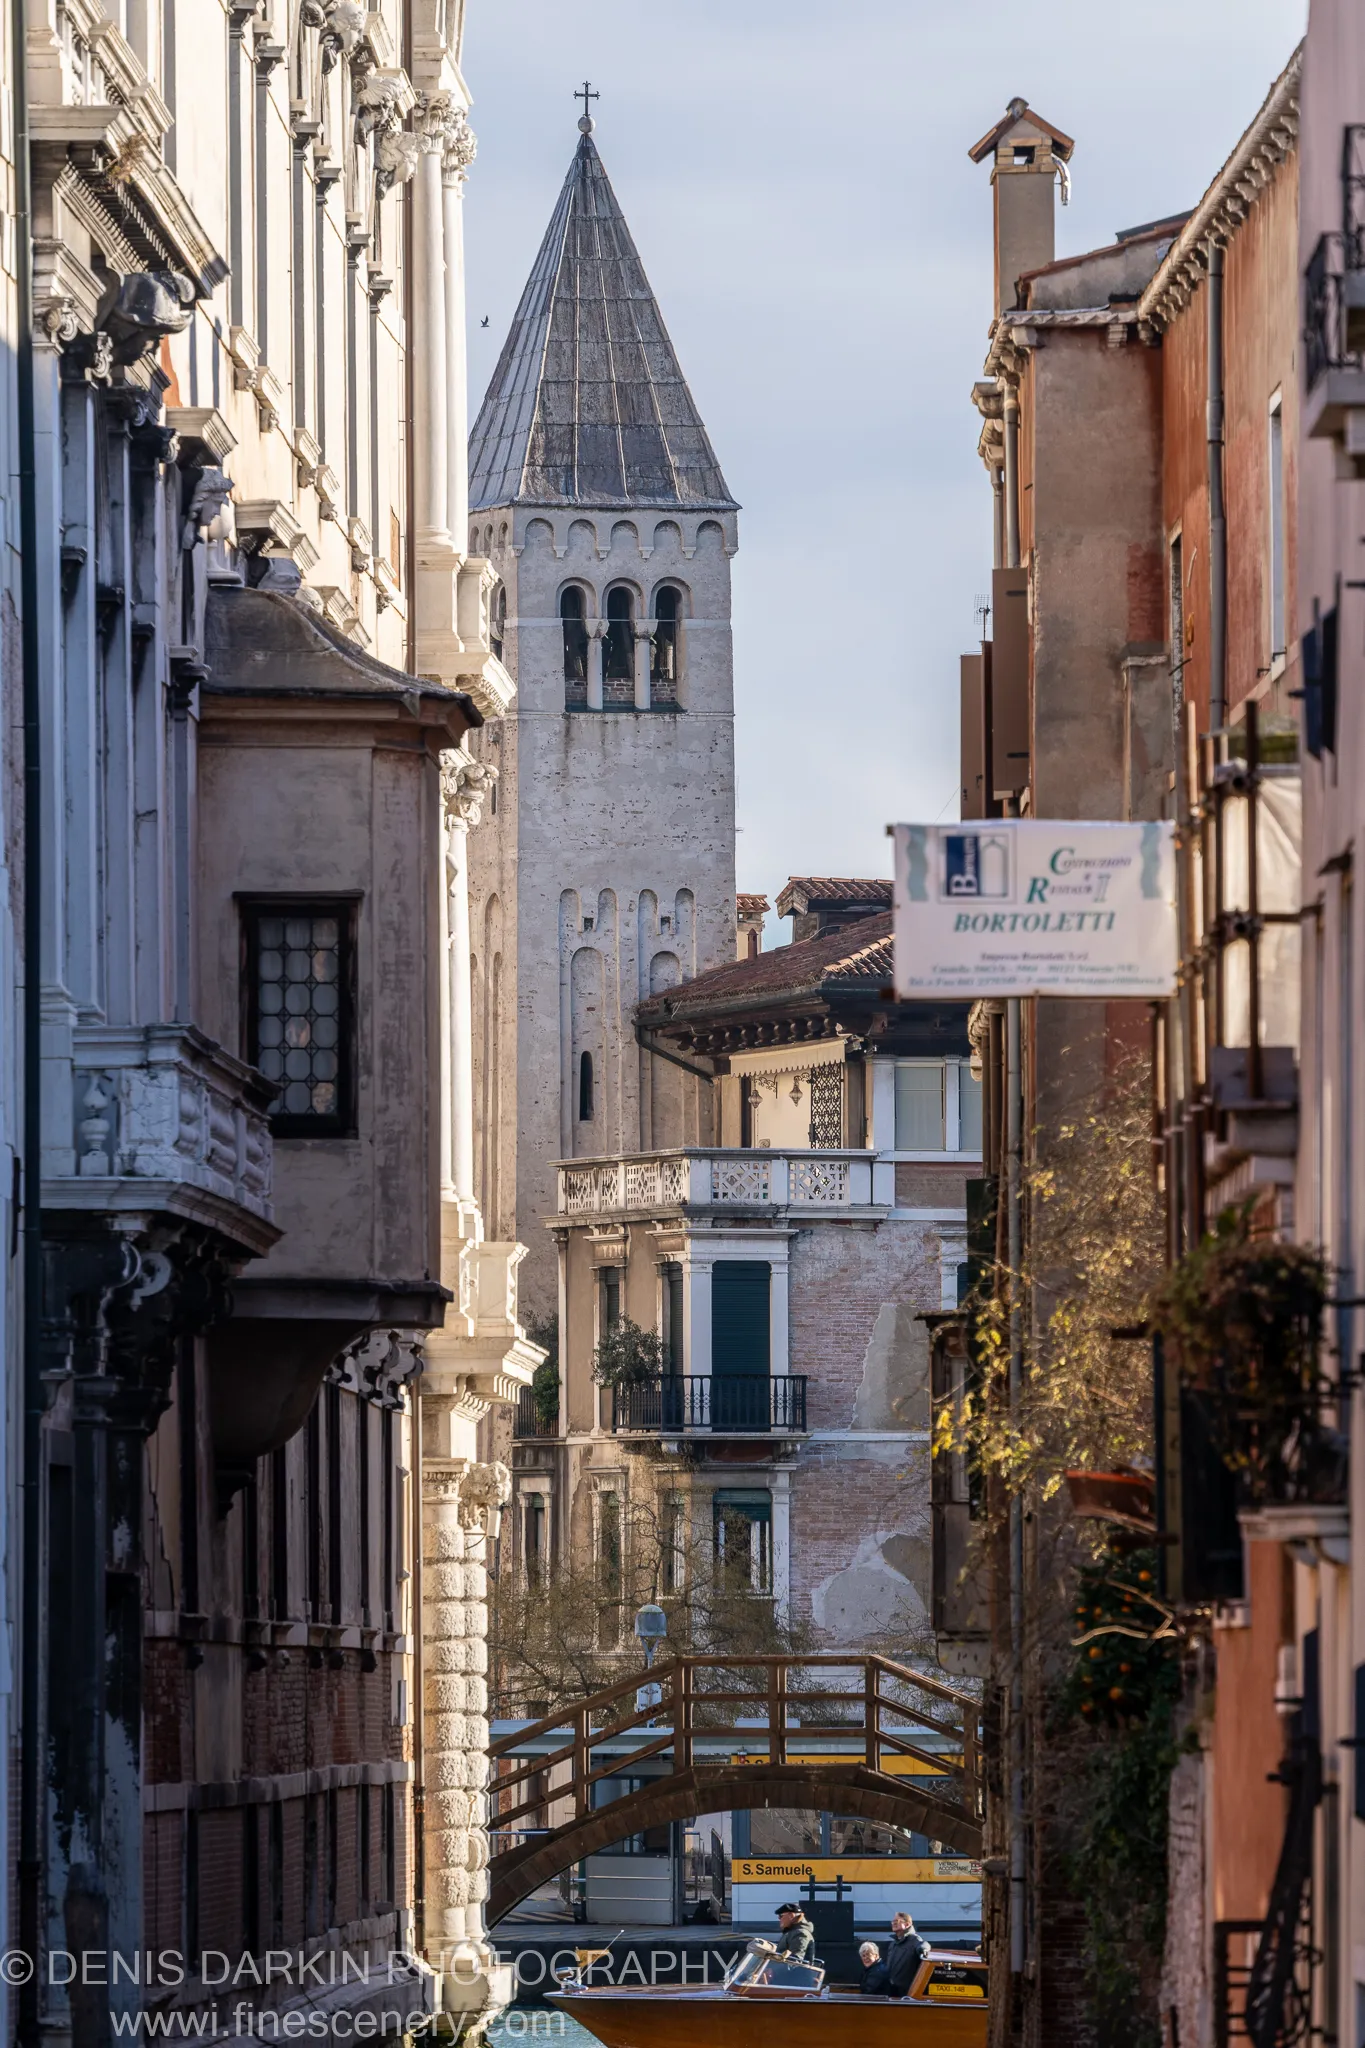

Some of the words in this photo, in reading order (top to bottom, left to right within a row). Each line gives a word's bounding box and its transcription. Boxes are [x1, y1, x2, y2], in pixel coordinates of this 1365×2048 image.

[954, 910, 1117, 933] BORTOLETTI
[742, 1863, 754, 1876] S.
[756, 1863, 813, 1876] Samuele
